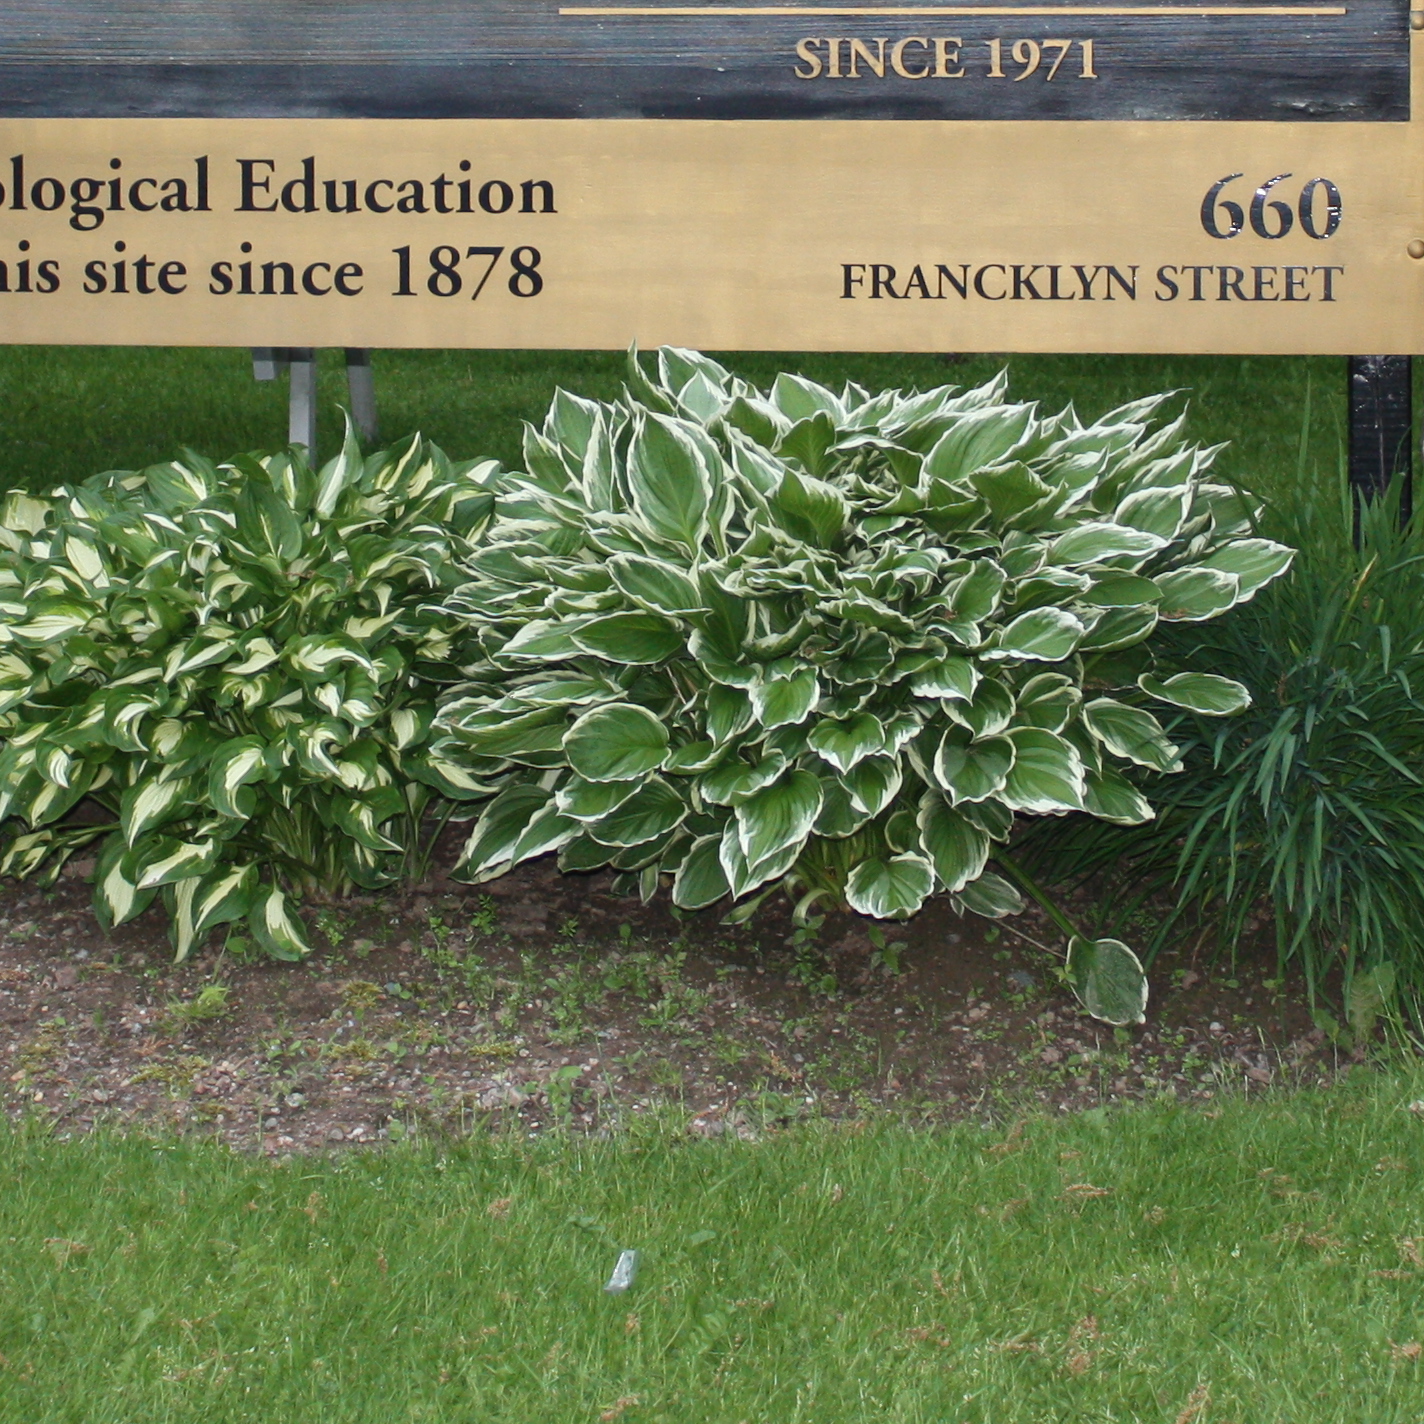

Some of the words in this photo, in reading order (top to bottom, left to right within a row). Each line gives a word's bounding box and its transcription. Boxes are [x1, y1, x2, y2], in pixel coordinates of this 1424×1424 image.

[794, 37, 965, 79] SINCE
[987, 39, 1098, 81] 1971
[235, 157, 557, 213] Education
[1200, 172, 1344, 240] 660
[84, 241, 187, 295] site
[210, 242, 363, 297] since
[393, 246, 542, 301] 1878
[840, 263, 1140, 301] FRANCKLYN
[1155, 263, 1345, 302] STREET
